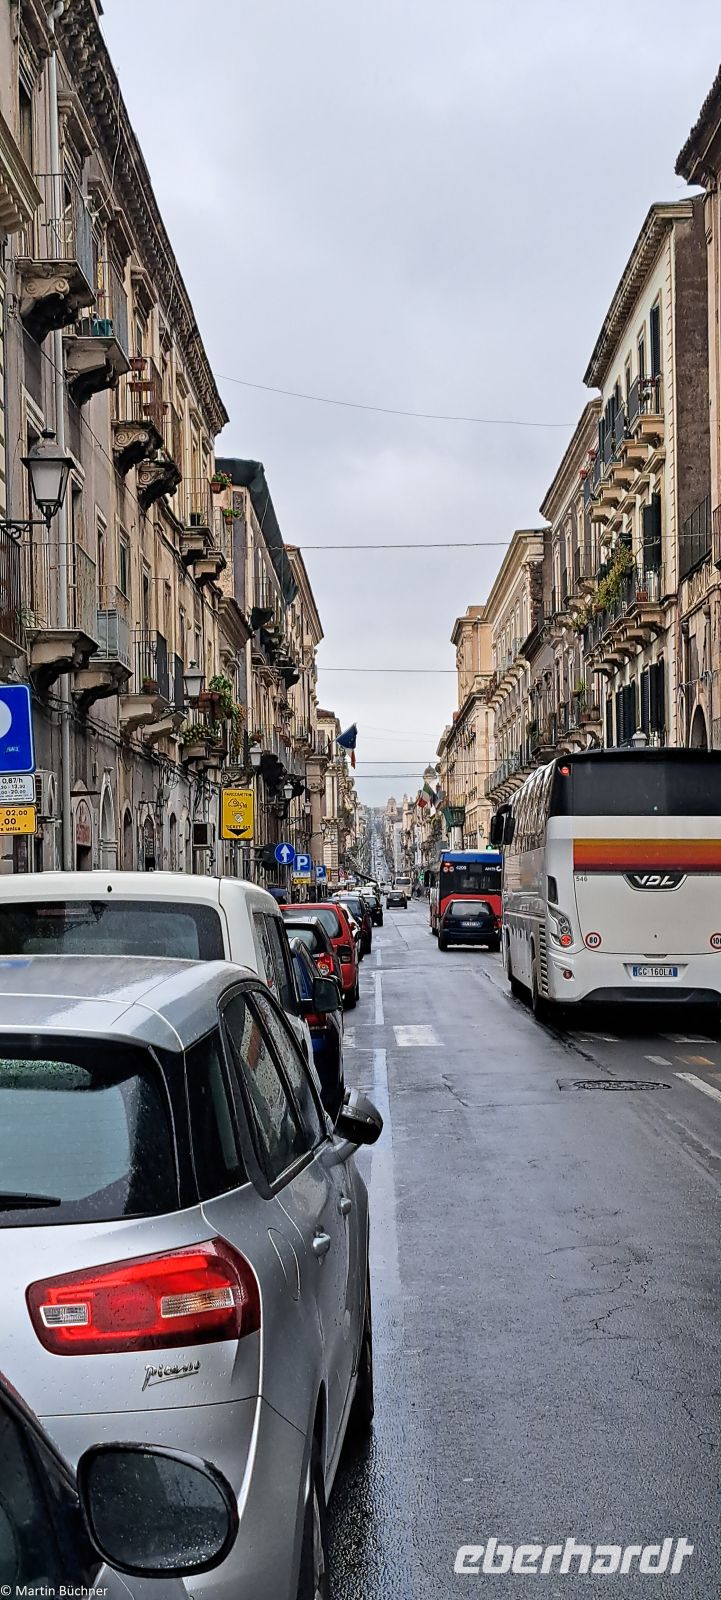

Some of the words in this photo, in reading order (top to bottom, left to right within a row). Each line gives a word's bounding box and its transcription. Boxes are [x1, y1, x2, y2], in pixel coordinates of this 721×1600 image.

[297, 855, 308, 870] P
[316, 867, 324, 876] P
[634, 875, 675, 886] VDL
[589, 936, 598, 944] 80
